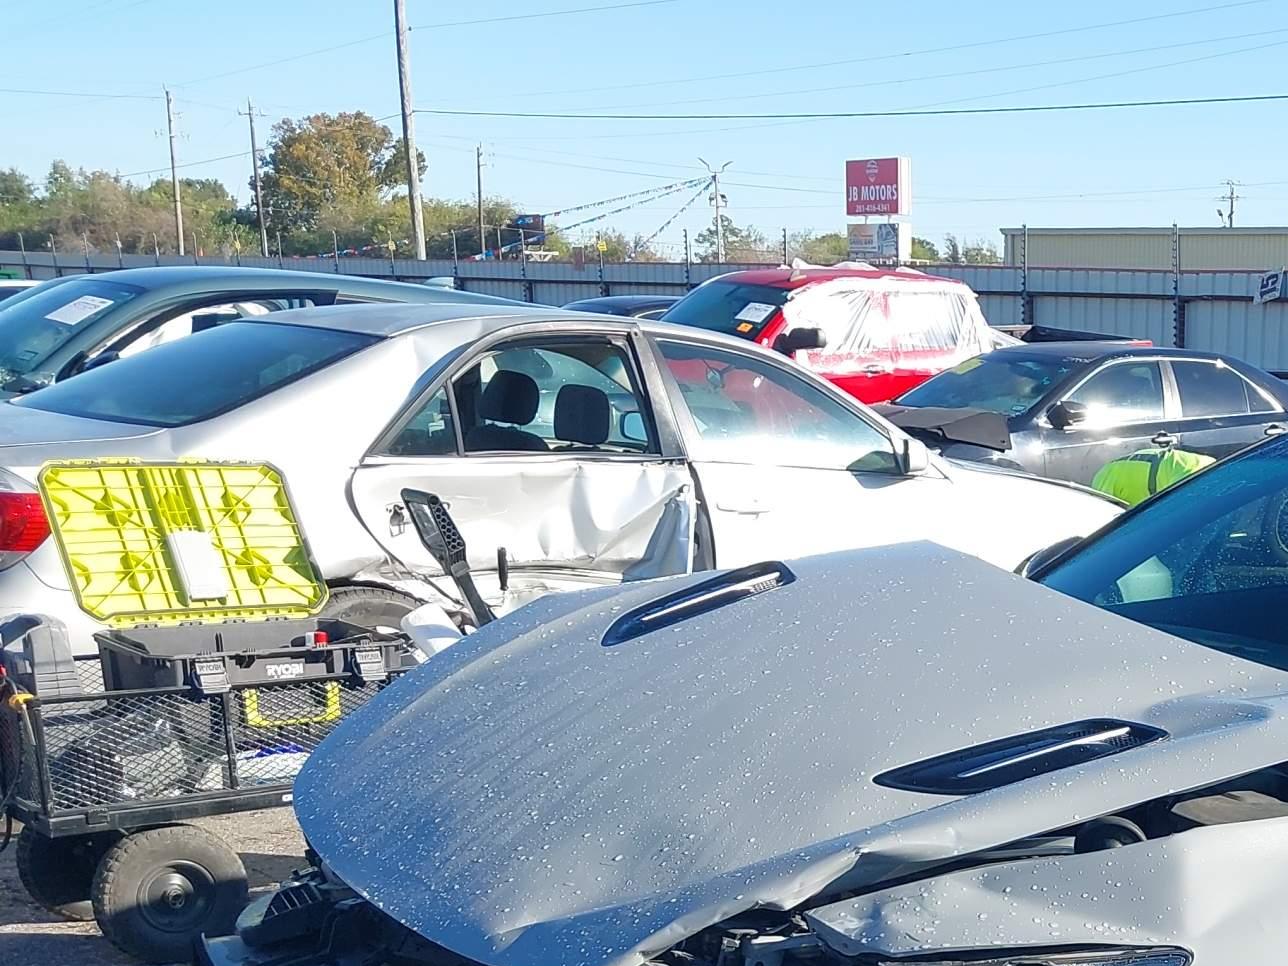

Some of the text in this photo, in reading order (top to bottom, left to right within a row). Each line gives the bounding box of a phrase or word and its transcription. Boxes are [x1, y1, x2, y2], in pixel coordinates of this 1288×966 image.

[848, 184, 897, 202] JB MOTORS
[265, 663, 303, 676] RYOBI
